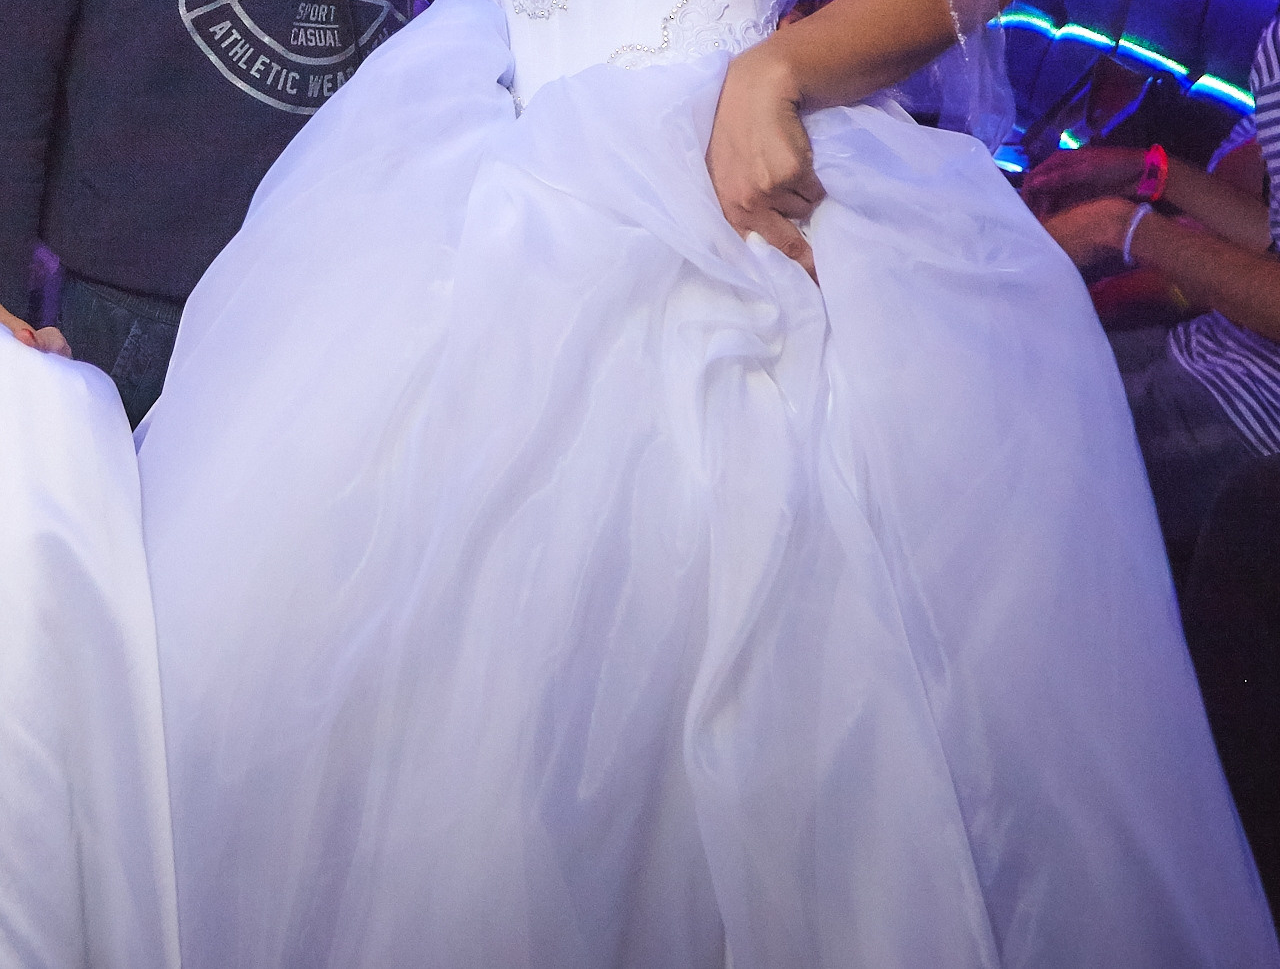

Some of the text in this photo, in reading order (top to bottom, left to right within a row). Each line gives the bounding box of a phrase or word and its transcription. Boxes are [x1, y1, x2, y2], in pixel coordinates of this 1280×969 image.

[296, 3, 337, 23] SPORT
[290, 28, 342, 48] CASUAL
[209, 19, 298, 96] ATHLETIC
